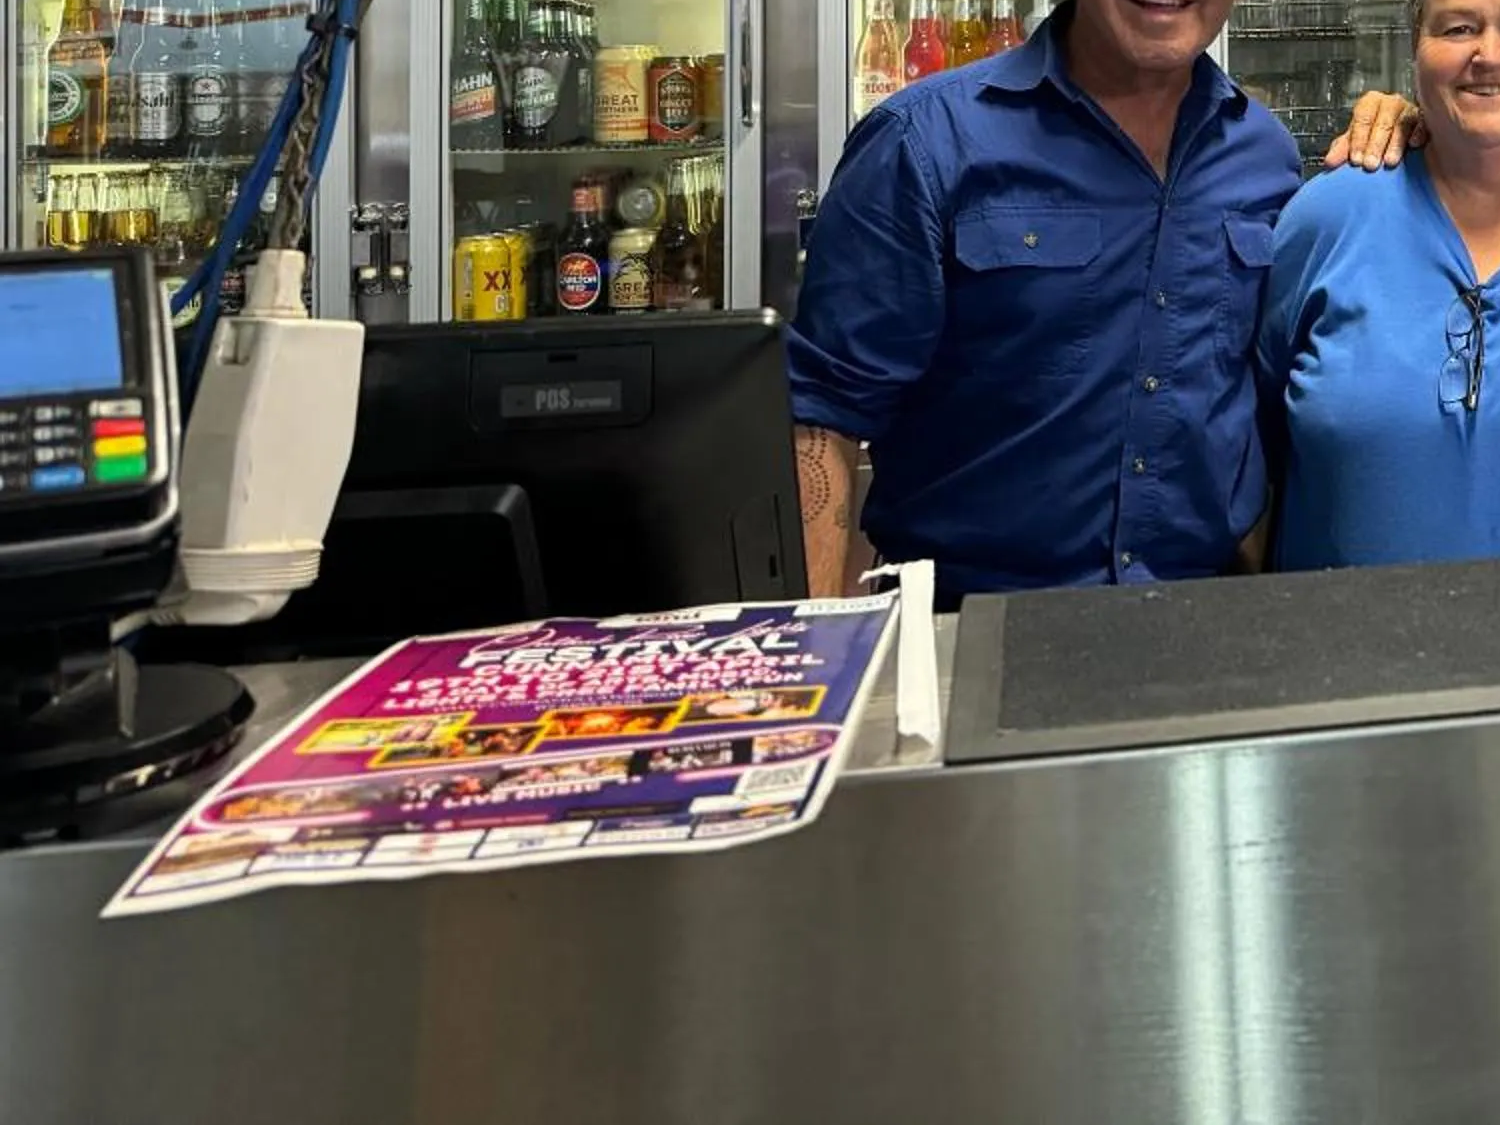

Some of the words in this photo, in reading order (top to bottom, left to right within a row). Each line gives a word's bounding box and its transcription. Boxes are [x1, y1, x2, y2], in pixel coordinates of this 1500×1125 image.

[535, 387, 572, 411] POS
[459, 633, 800, 668] FESTIVAL
[691, 654, 825, 673] APRIL
